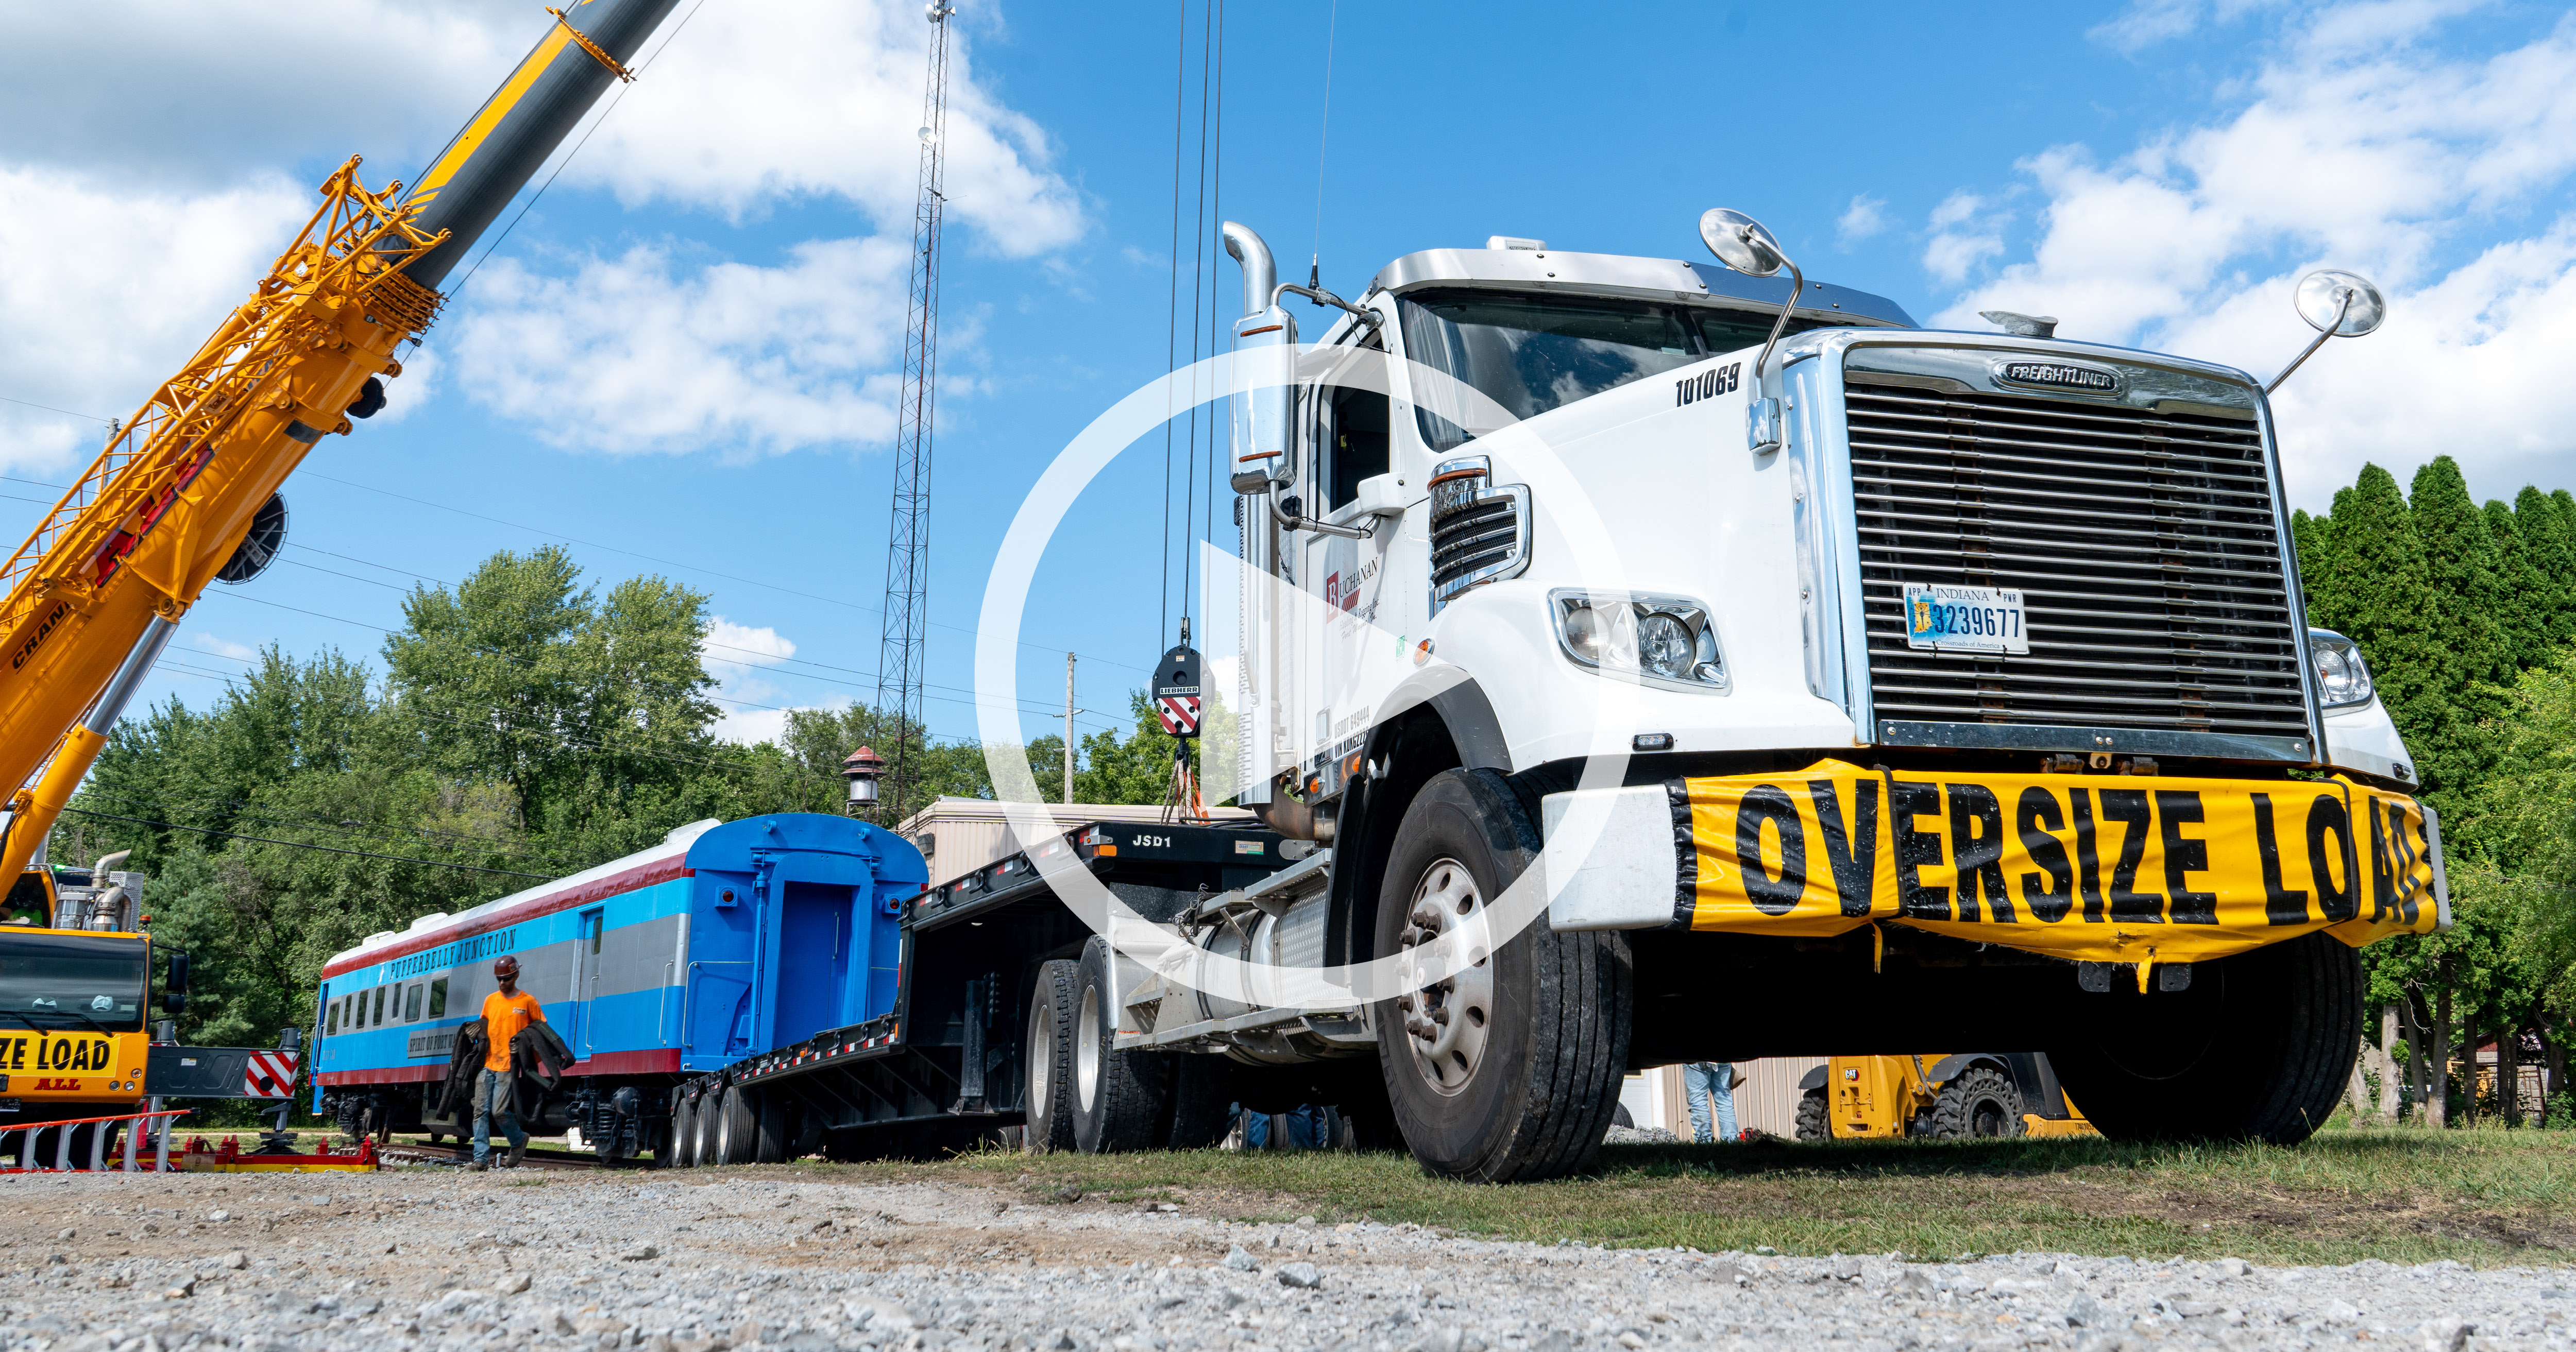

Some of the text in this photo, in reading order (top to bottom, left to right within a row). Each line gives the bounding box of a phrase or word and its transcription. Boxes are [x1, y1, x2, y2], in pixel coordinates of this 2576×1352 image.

[1676, 362, 1741, 407] 101069
[2011, 366, 2111, 387] FREIGHTLINER
[1328, 556, 1378, 615] BUCHANAN
[1908, 588, 1921, 596] APP
[1936, 588, 1990, 601] INDIANA
[1340, 616, 1353, 631] Hauling
[1354, 612, 1358, 621] &
[1358, 603, 1372, 619] Rigging
[1933, 605, 2019, 638] 3239677
[12, 602, 71, 670] CRAN
[1341, 629, 1351, 643] Fort
[1334, 716, 1349, 739] USDOT
[1133, 834, 1171, 847] JSD1
[1735, 779, 2219, 925] OVERSIZE
[389, 929, 516, 980] PUFFERBELLY JUNCTION
[37, 1038, 110, 1070] LOAD
[410, 1037, 426, 1052] SPIRIT
[427, 1035, 434, 1051] OF
[433, 1034, 448, 1050] FORT
[34, 1079, 81, 1090] ALL
[1845, 1069, 1856, 1080] CAT
